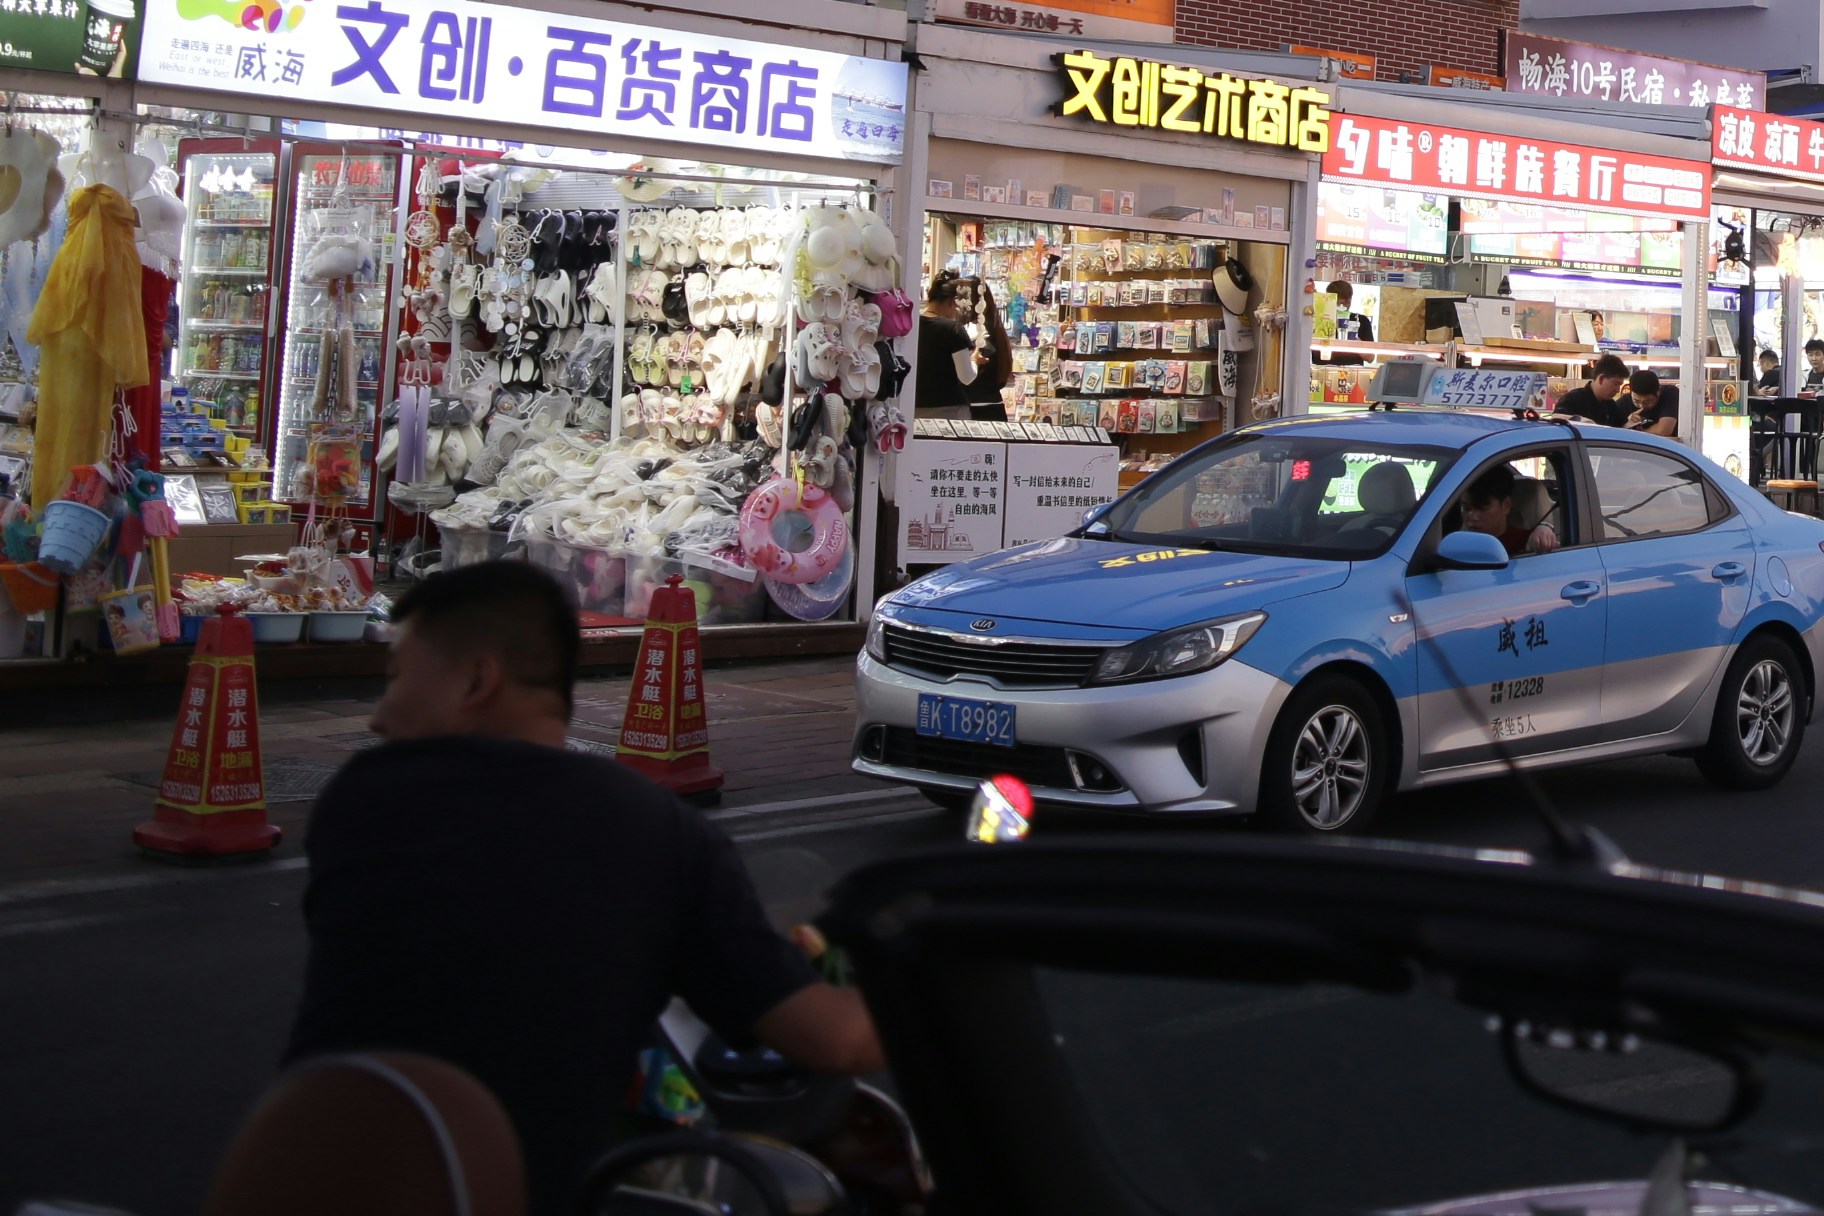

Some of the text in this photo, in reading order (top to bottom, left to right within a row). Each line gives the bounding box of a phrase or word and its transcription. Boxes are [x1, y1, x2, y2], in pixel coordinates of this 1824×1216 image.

[965, 1, 1083, 35] 看看大海 开心每一天
[171, 38, 210, 53] 走遍四海
[234, 42, 305, 86] 威海
[331, 0, 819, 142] 文创·百货商店
[1061, 49, 1331, 153] 文创艺术商店
[1438, 134, 1618, 202] 朝鲜族餐厅
[1446, 371, 1531, 393] 斯麦尔口腔
[1441, 392, 1523, 407] 5773777
[984, 453, 996, 465] 嗨!
[930, 469, 999, 482] 请你不要走的太快
[954, 503, 997, 516] 自由的海风
[641, 649, 665, 702] 潜水艇
[1507, 677, 1544, 700] 12328
[180, 687, 207, 748] 潜水艇
[227, 688, 248, 749] 潜水艇
[633, 703, 664, 720] 卫浴
[172, 748, 200, 768] 卫浴
[219, 751, 254, 769] 地漏
